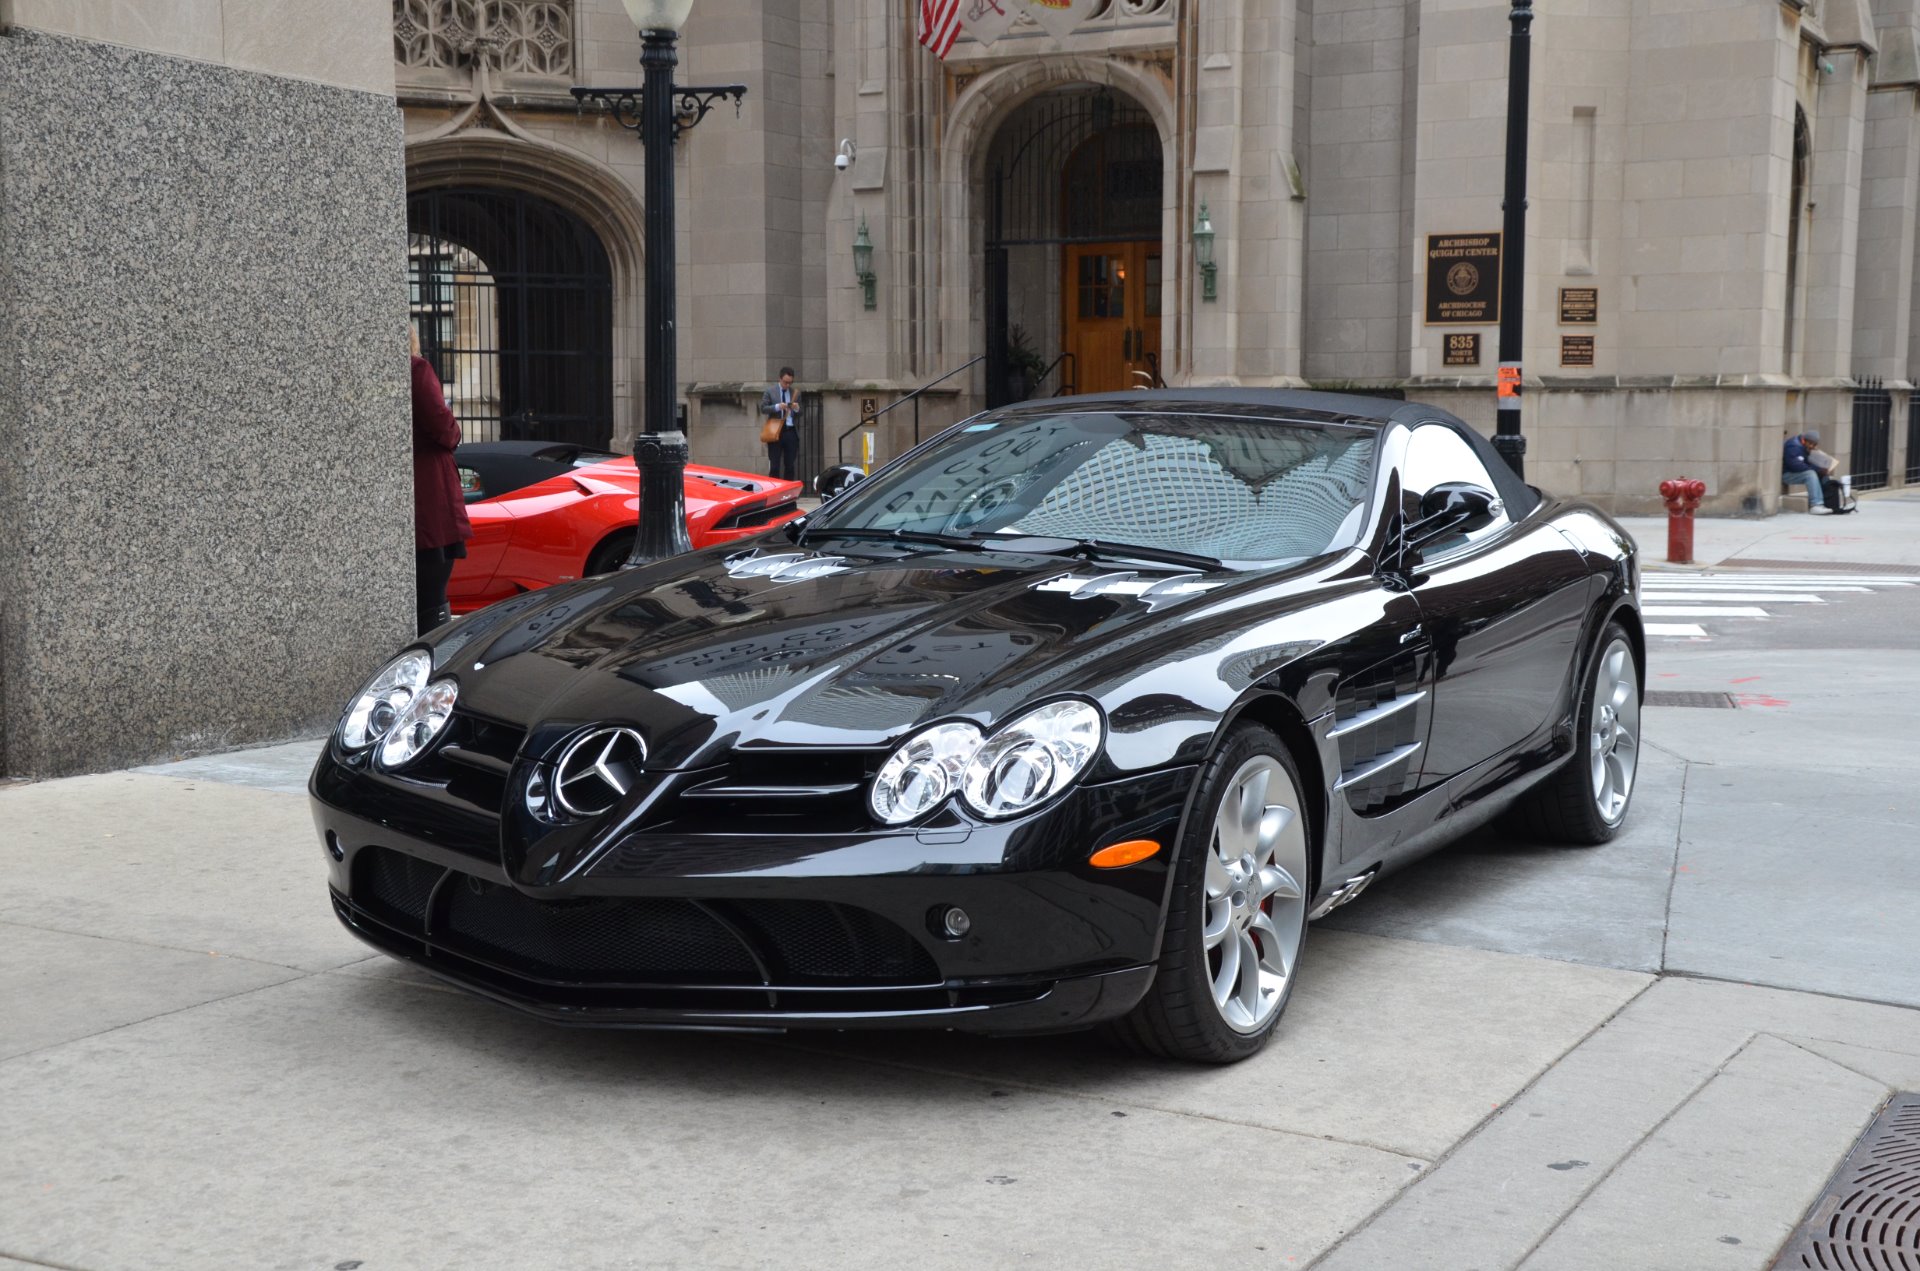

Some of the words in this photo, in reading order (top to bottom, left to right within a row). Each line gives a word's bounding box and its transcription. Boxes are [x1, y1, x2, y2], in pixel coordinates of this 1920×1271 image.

[1438, 238, 1490, 247] ARCHBISHOP
[1430, 248, 1464, 258] QUIGLEY
[1465, 247, 1498, 256] CENTER
[1450, 335, 1474, 349] 835
